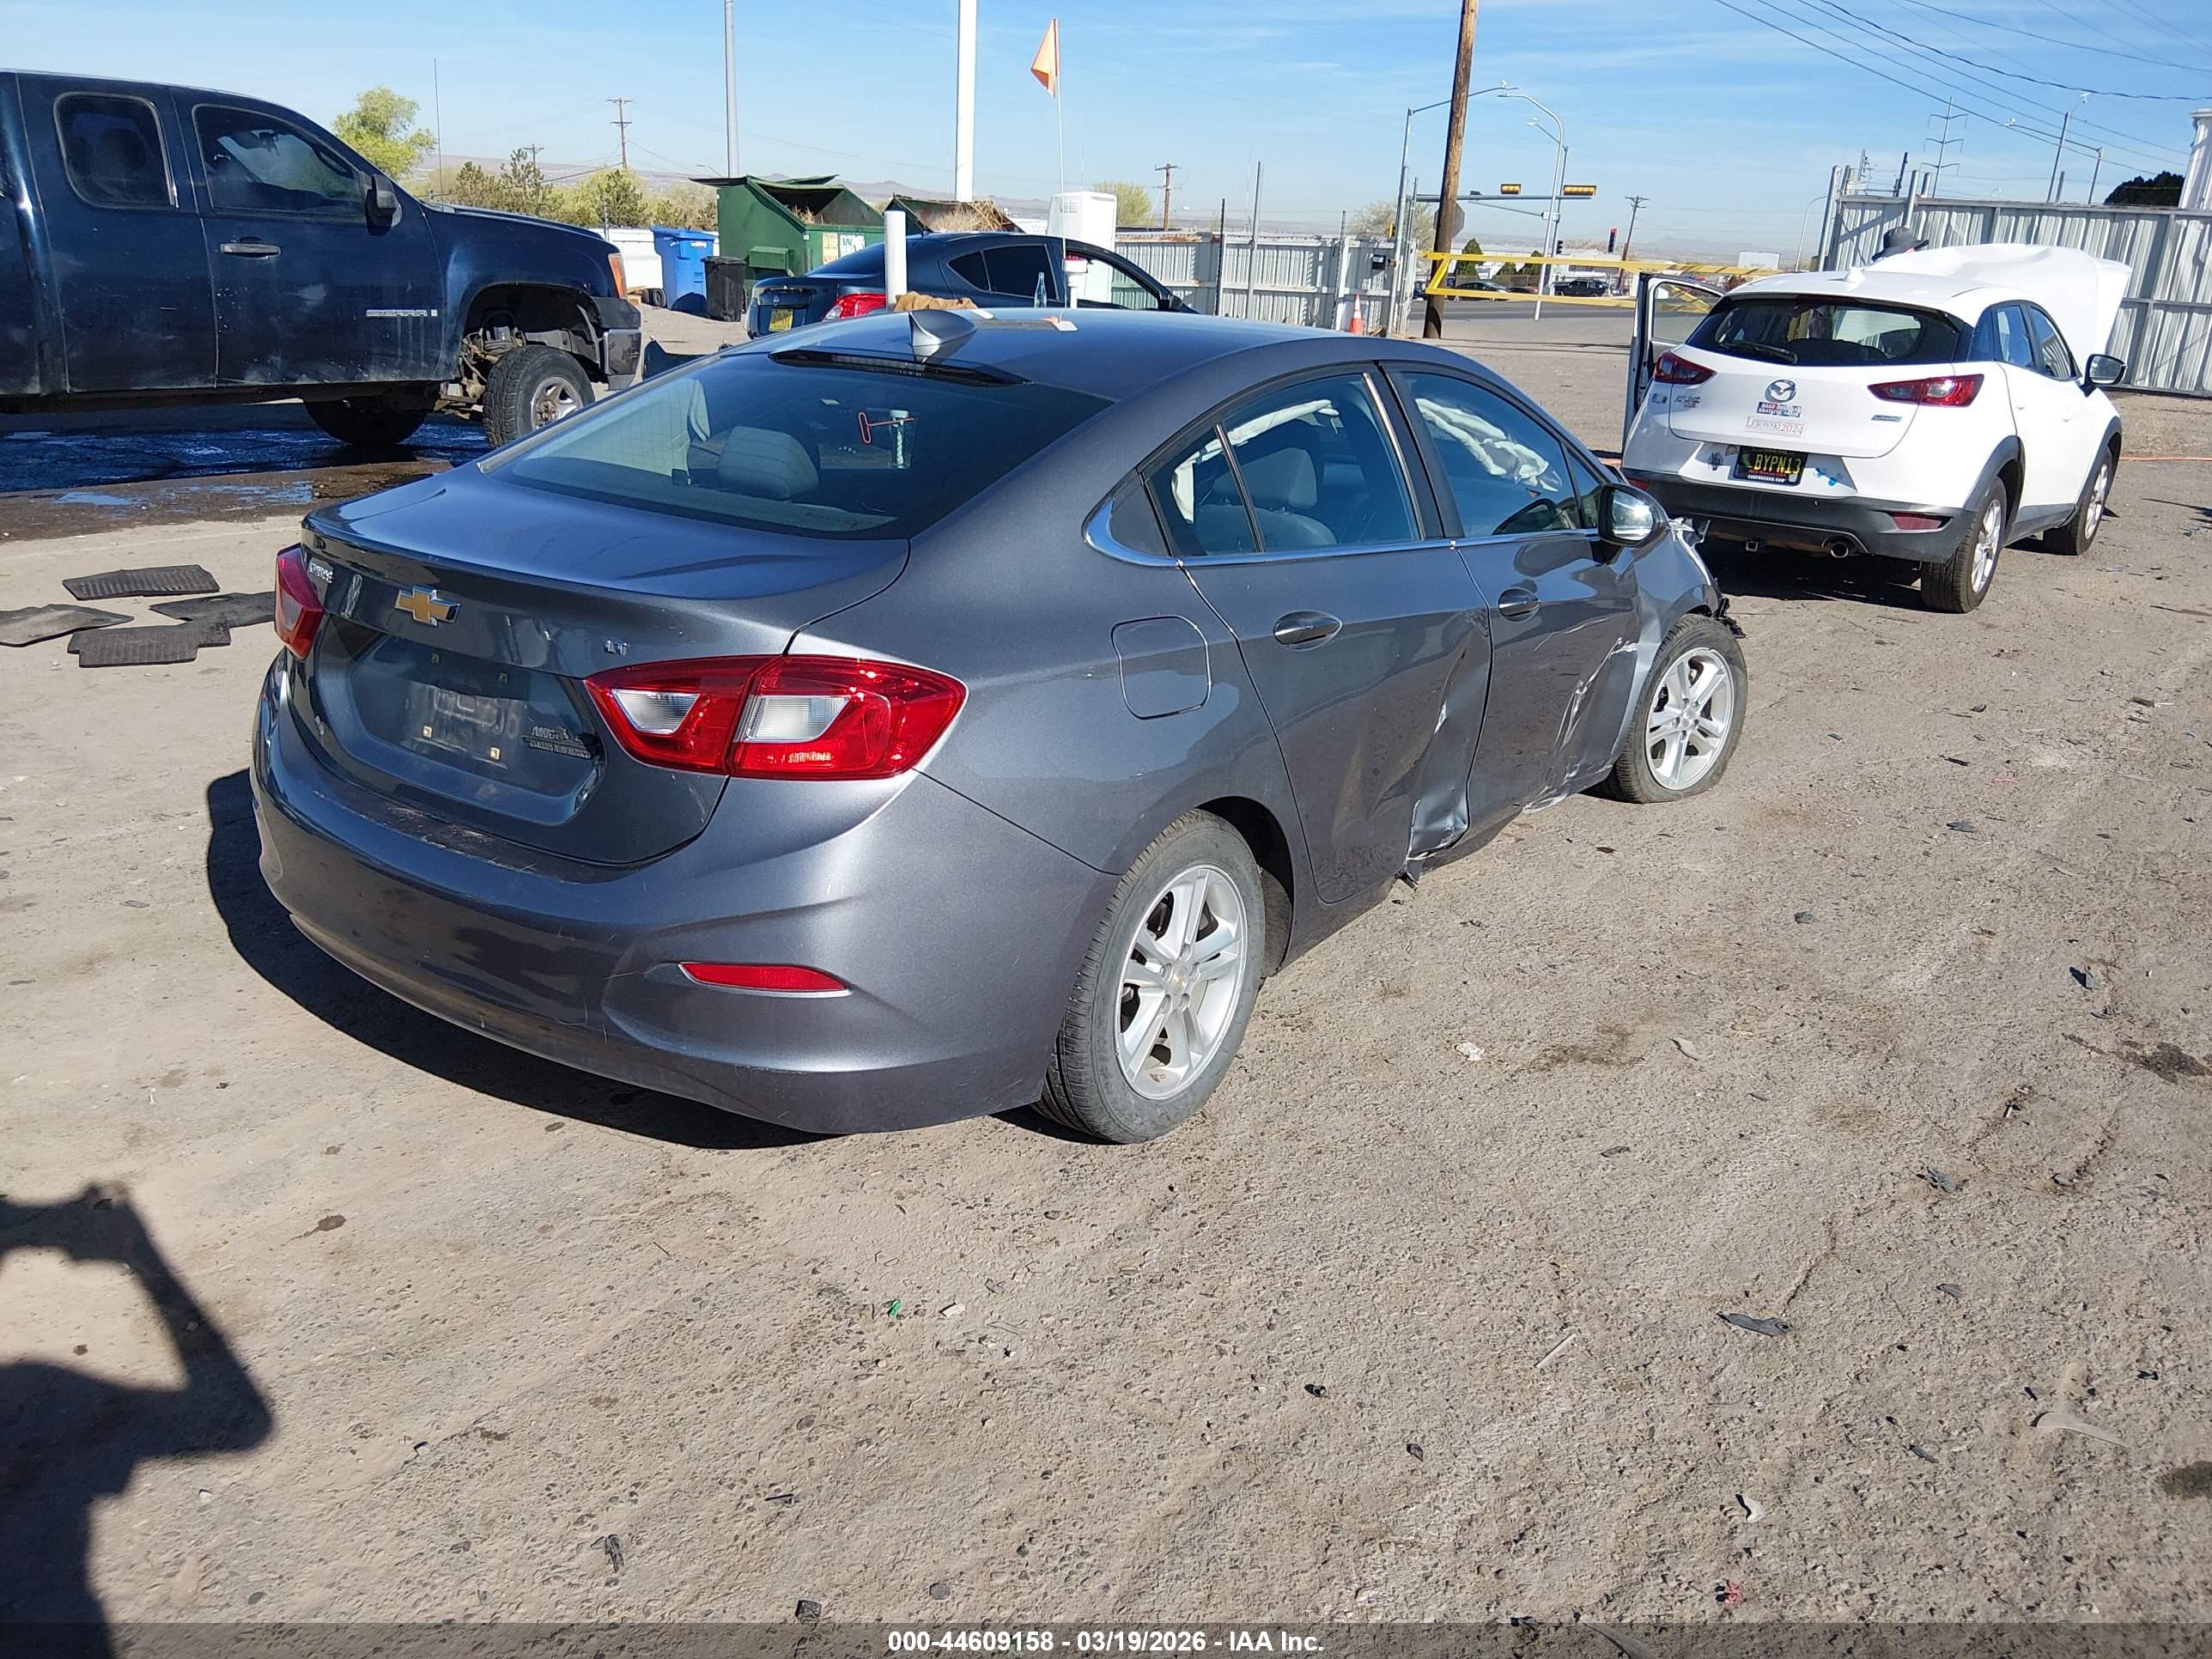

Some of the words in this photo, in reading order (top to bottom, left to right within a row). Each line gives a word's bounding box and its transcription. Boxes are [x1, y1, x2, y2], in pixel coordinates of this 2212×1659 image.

[366, 308, 428, 317] SIERRA
[1780, 424, 1804, 434] 2024
[1753, 453, 1802, 475] BYPN13
